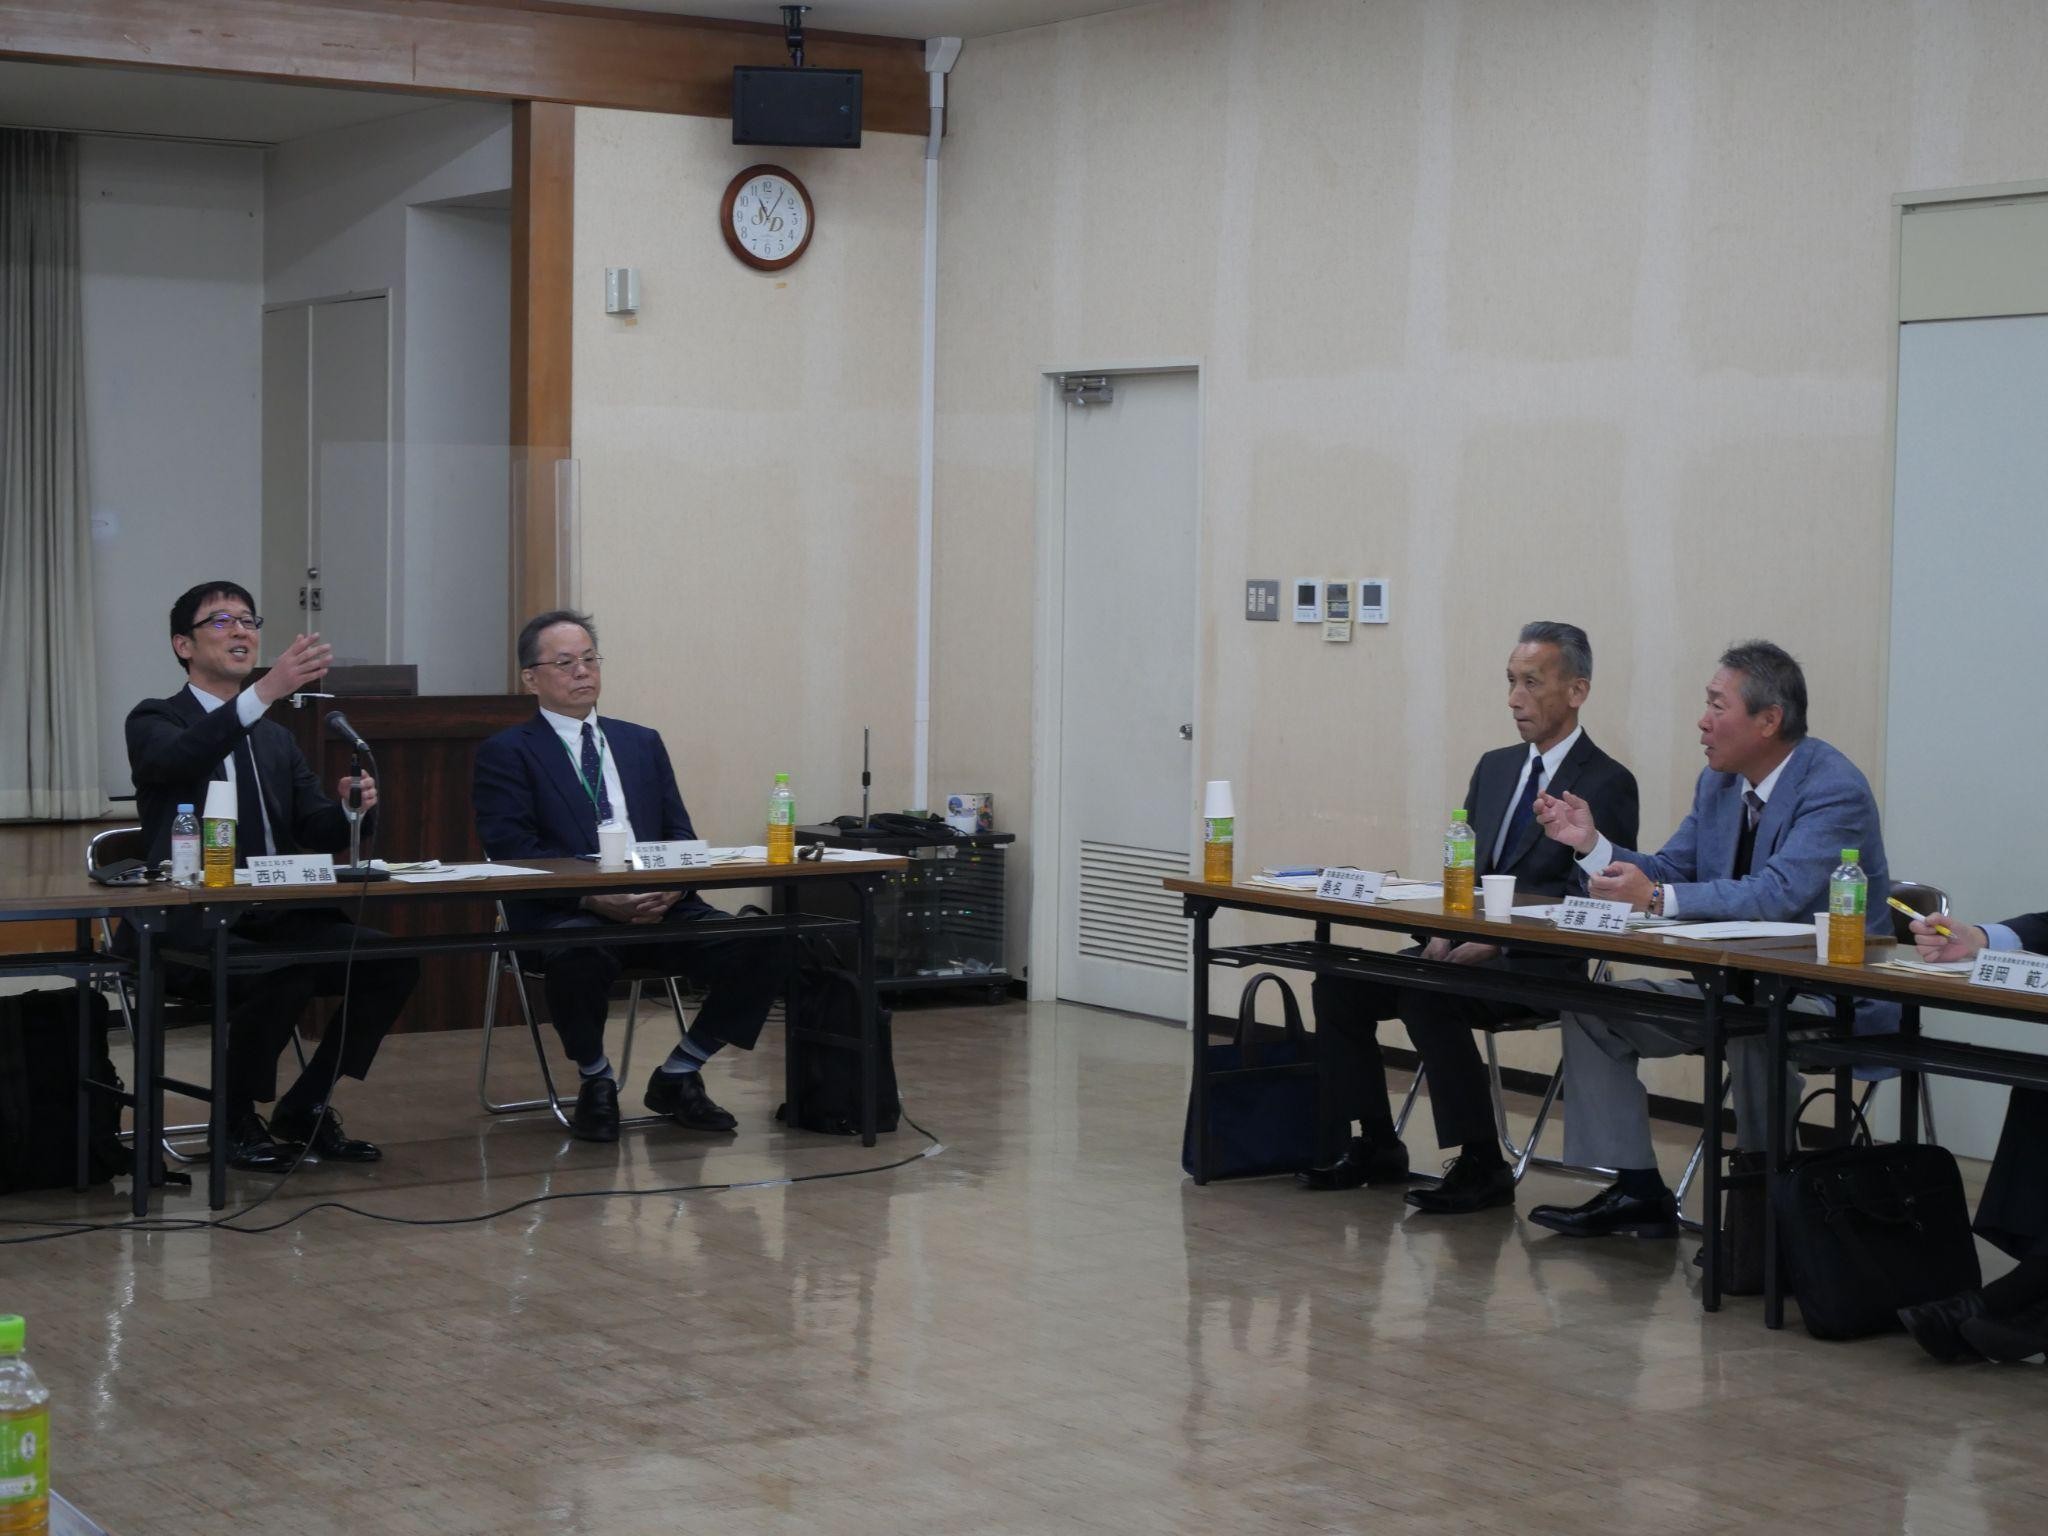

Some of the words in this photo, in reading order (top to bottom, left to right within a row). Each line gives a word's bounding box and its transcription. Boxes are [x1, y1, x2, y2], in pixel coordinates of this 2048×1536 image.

[640, 854, 666, 868] 菊池
[680, 853, 707, 866] 宏二
[256, 869, 286, 883] 西内
[302, 867, 332, 882] 裕晶
[1563, 909, 1588, 926] 若藤
[1978, 963, 2010, 984] 程岡
